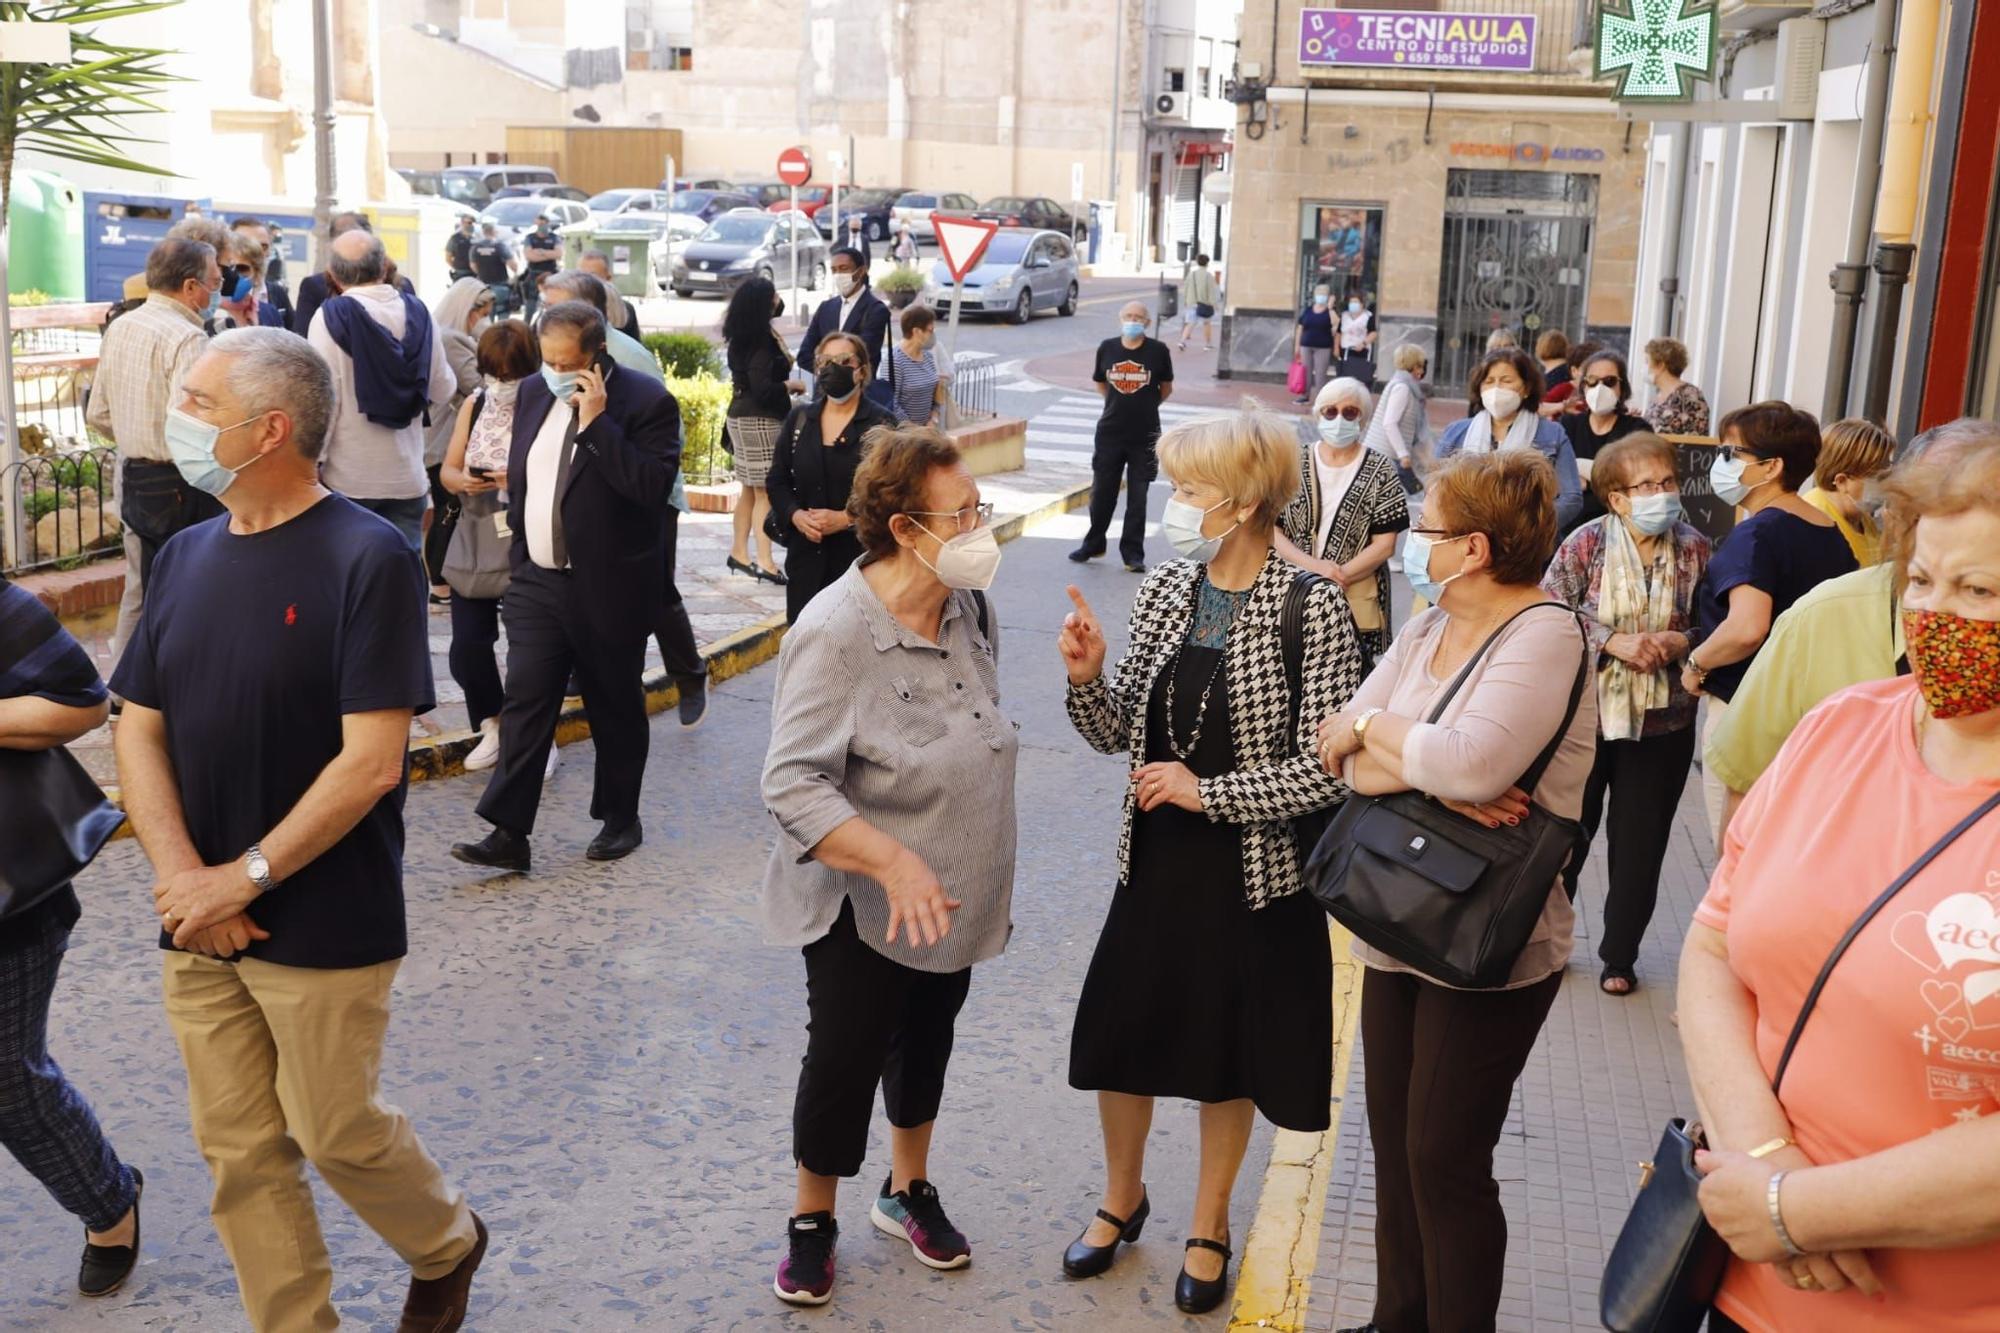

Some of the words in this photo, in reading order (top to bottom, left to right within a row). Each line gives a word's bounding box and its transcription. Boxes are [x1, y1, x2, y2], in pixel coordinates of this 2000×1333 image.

[1357, 15, 1528, 43] TECNIAULA
[1357, 38, 1418, 52] CENTRO
[1425, 41, 1444, 53] DE
[1453, 41, 1528, 56] ESTUDIOS
[1408, 52, 1430, 63] 659
[1434, 53, 1456, 64] 905
[1460, 54, 1482, 65] 146
